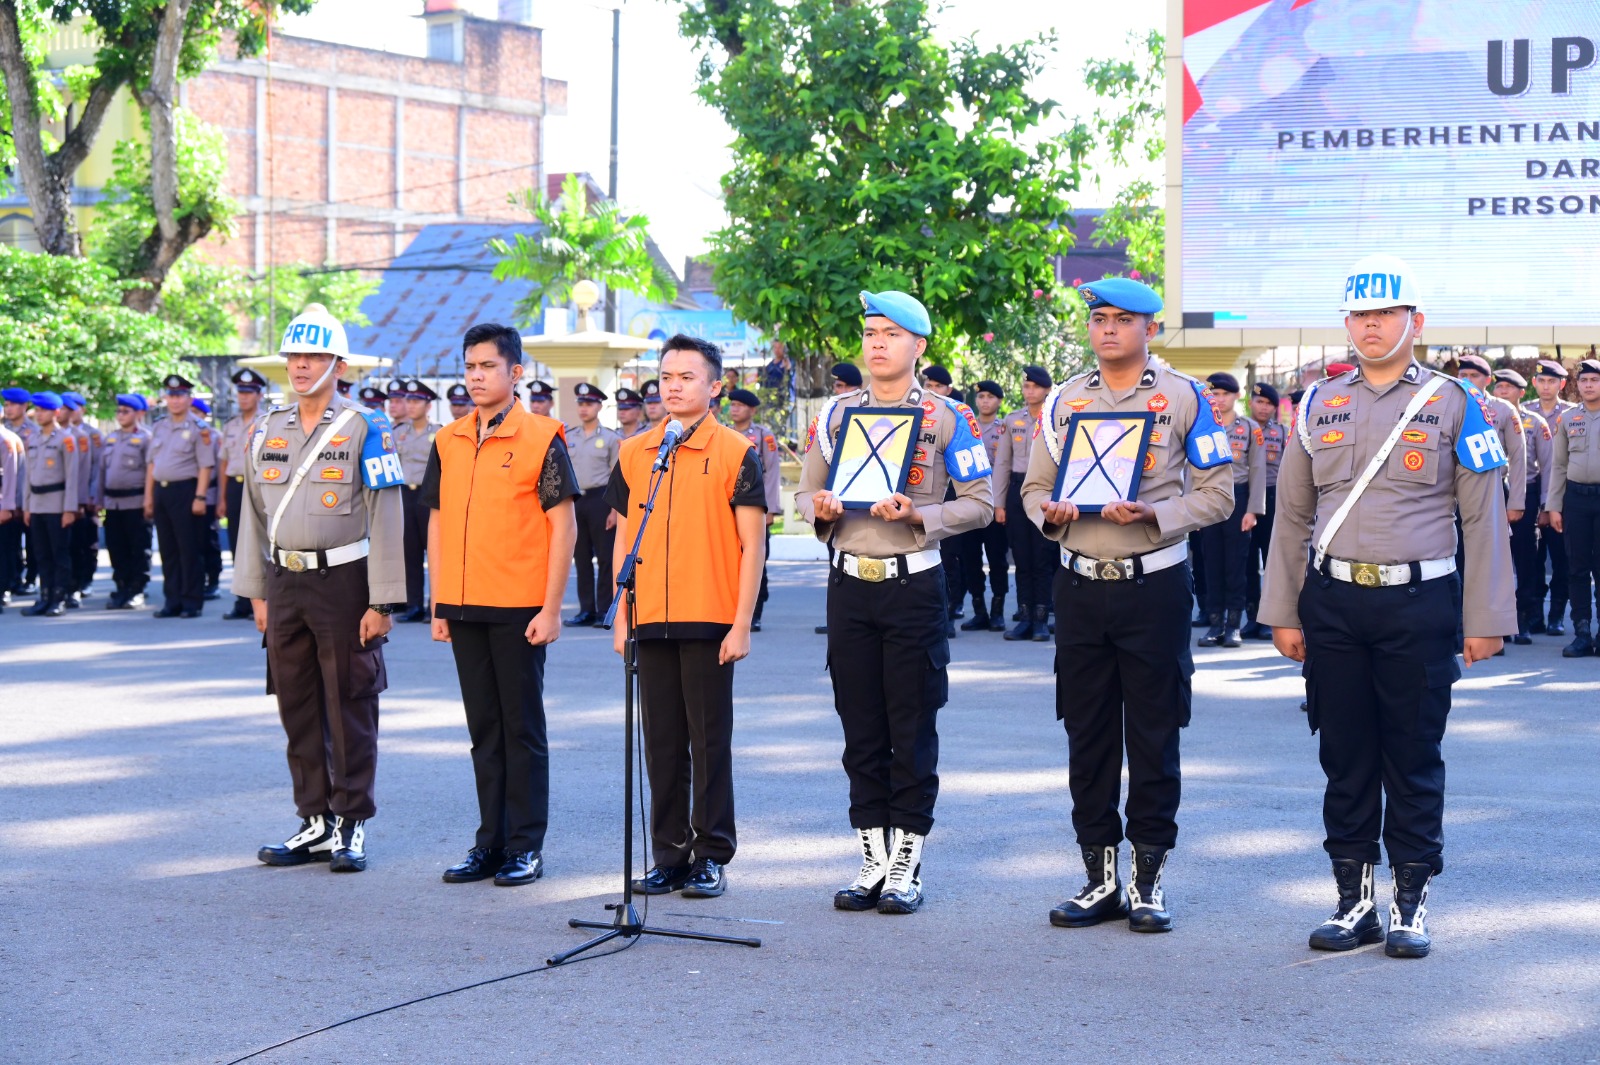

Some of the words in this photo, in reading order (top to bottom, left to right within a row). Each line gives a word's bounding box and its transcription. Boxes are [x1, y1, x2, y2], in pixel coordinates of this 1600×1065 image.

[1487, 36, 1596, 96] UP
[1277, 121, 1600, 149] PEMBERHENTIAN
[1526, 158, 1600, 179] DAR
[1344, 273, 1402, 302] PROV
[282, 323, 333, 348] PROV
[1060, 416, 1073, 427] LA
[1316, 412, 1351, 427] ALFIK
[317, 451, 350, 461] POLRI
[501, 451, 513, 468] 2
[701, 457, 710, 475] 1
